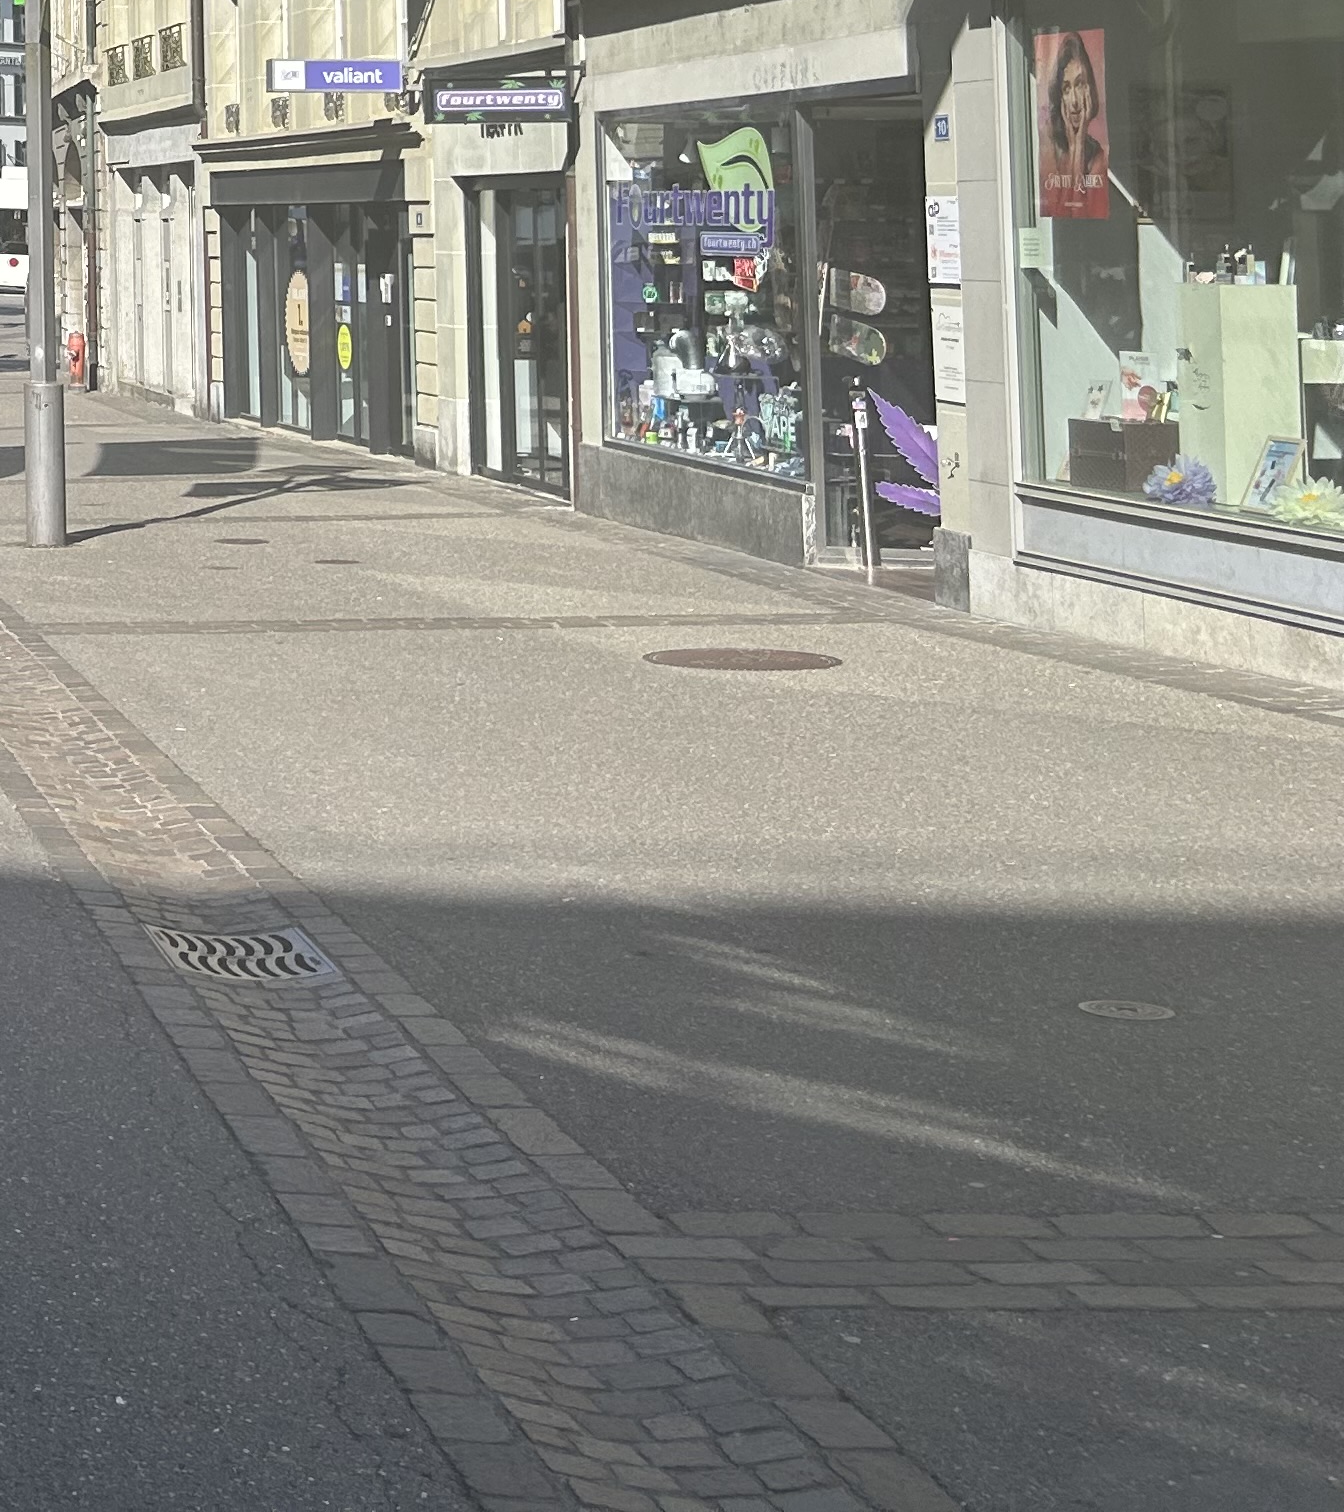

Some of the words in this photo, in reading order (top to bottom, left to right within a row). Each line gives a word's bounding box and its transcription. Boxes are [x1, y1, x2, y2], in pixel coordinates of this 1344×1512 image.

[323, 67, 384, 84] valiant
[440, 94, 560, 107] fourtwenty
[937, 119, 947, 136] 10
[616, 183, 776, 249] Fourtwenty
